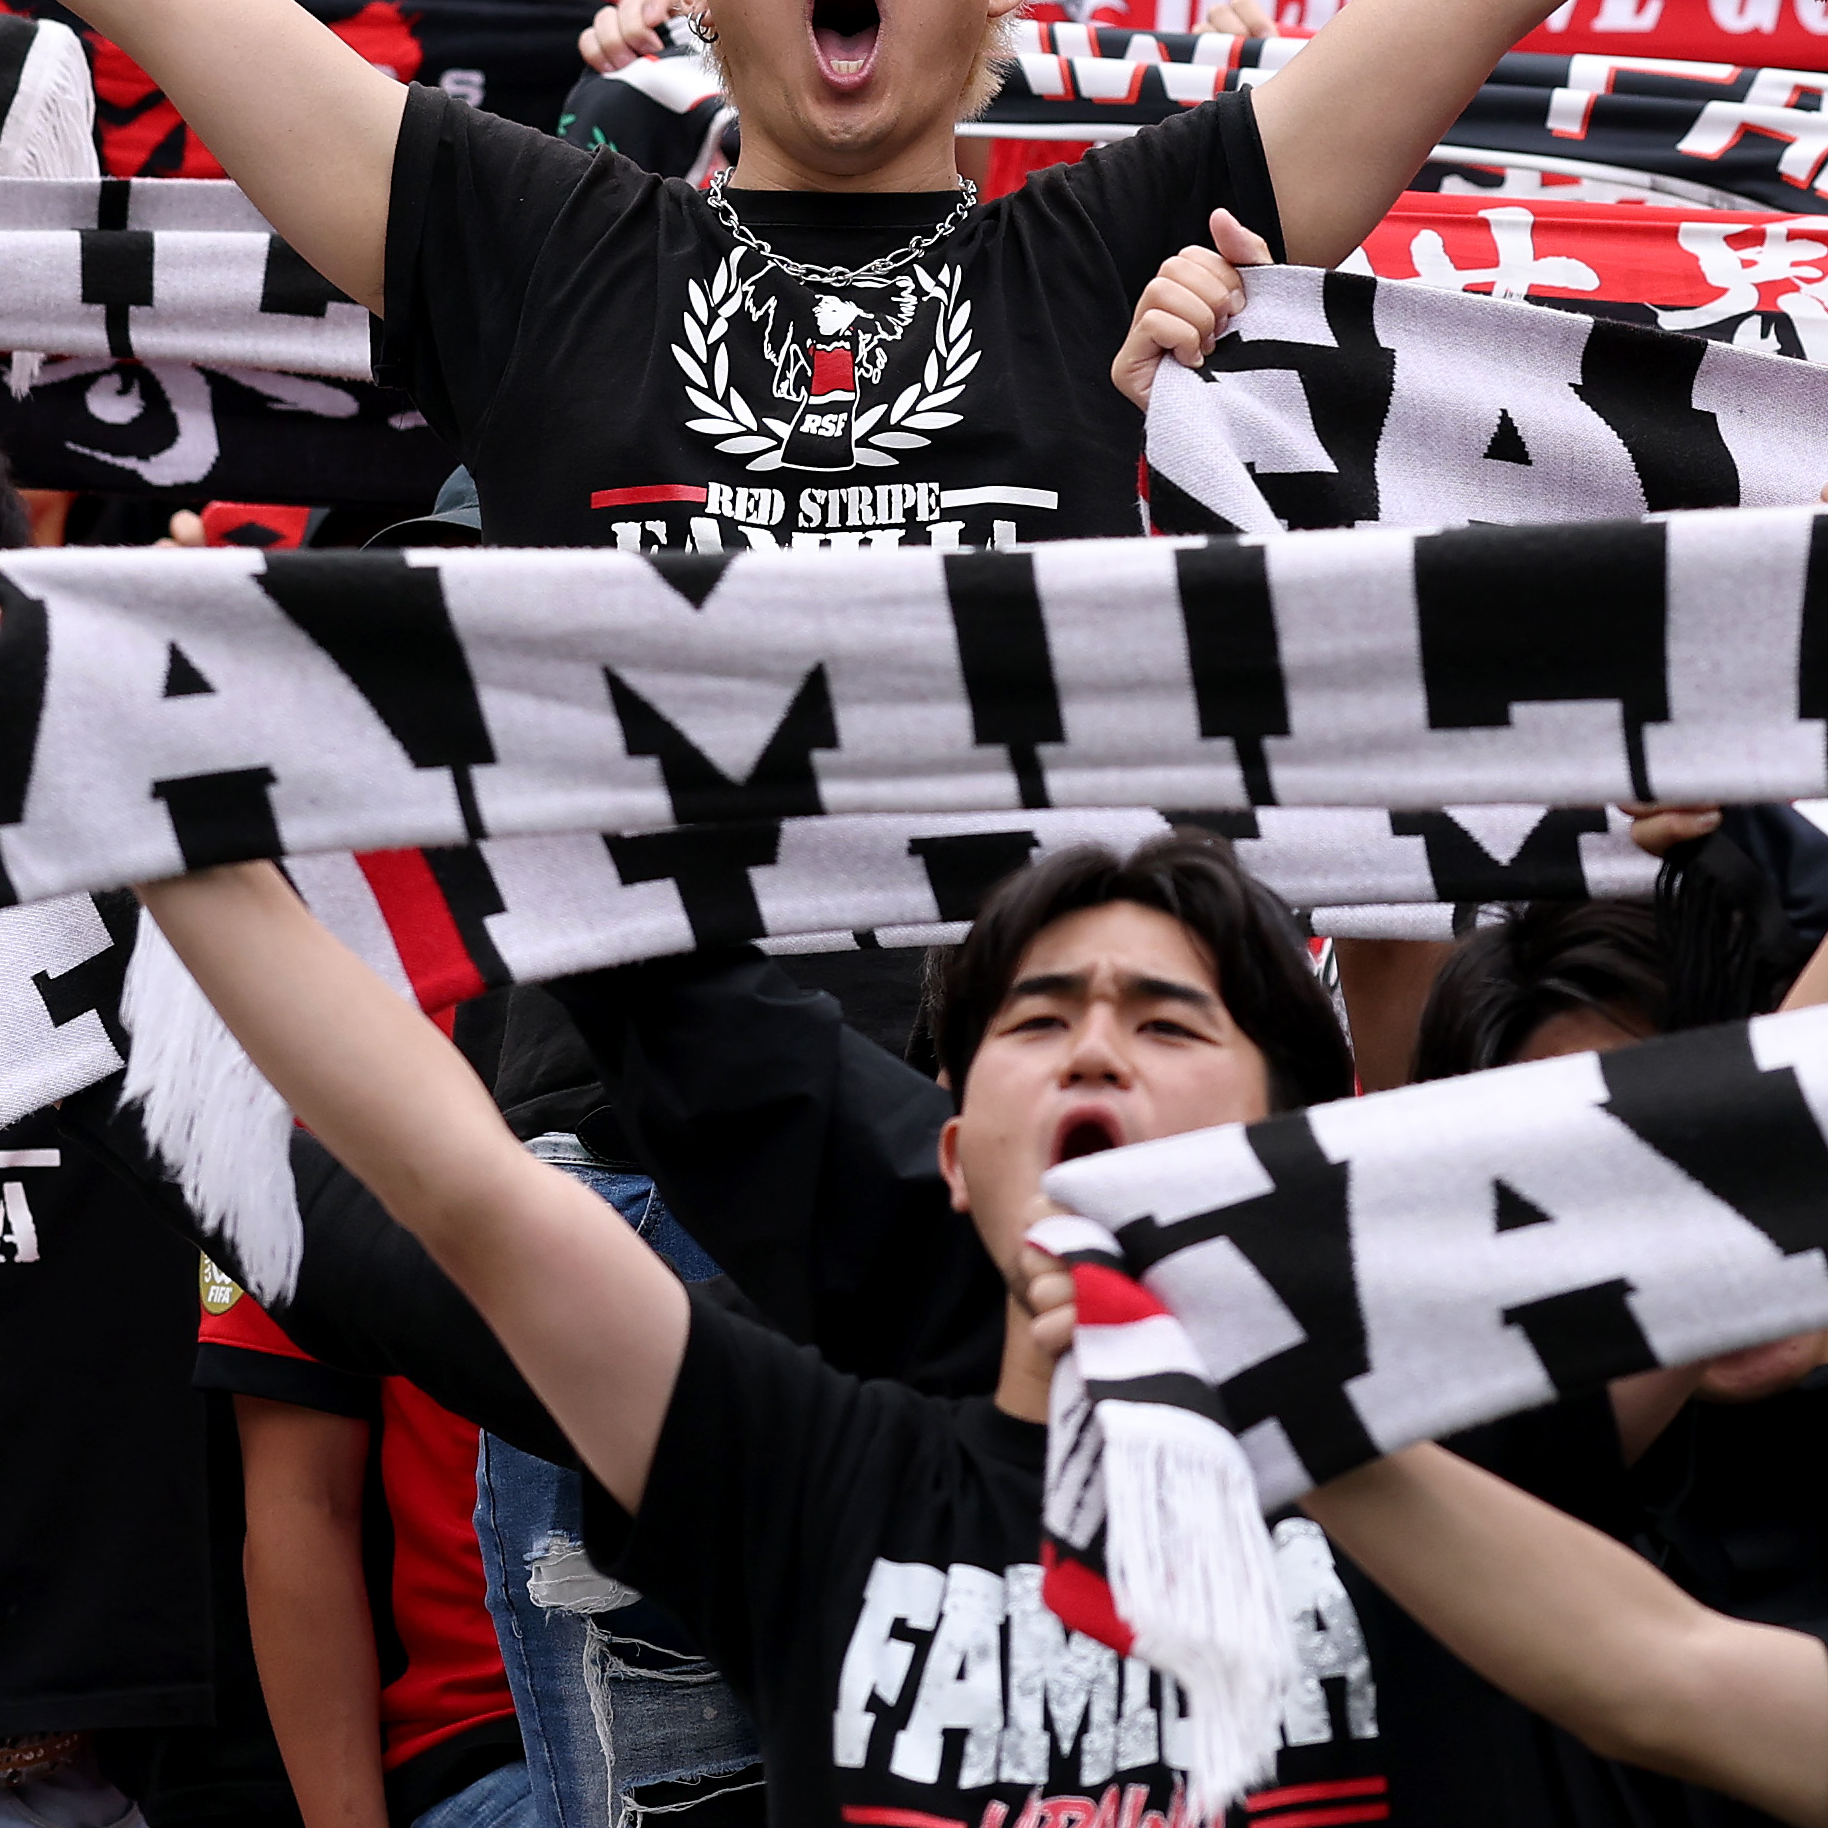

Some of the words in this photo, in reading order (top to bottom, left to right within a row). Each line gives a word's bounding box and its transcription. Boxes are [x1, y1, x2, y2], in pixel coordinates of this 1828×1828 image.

[704, 481, 786, 526] RED
[798, 481, 941, 528] STRIPE
[207, 1285, 233, 1304] FIFA
[832, 1515, 1379, 1789] FAMA
